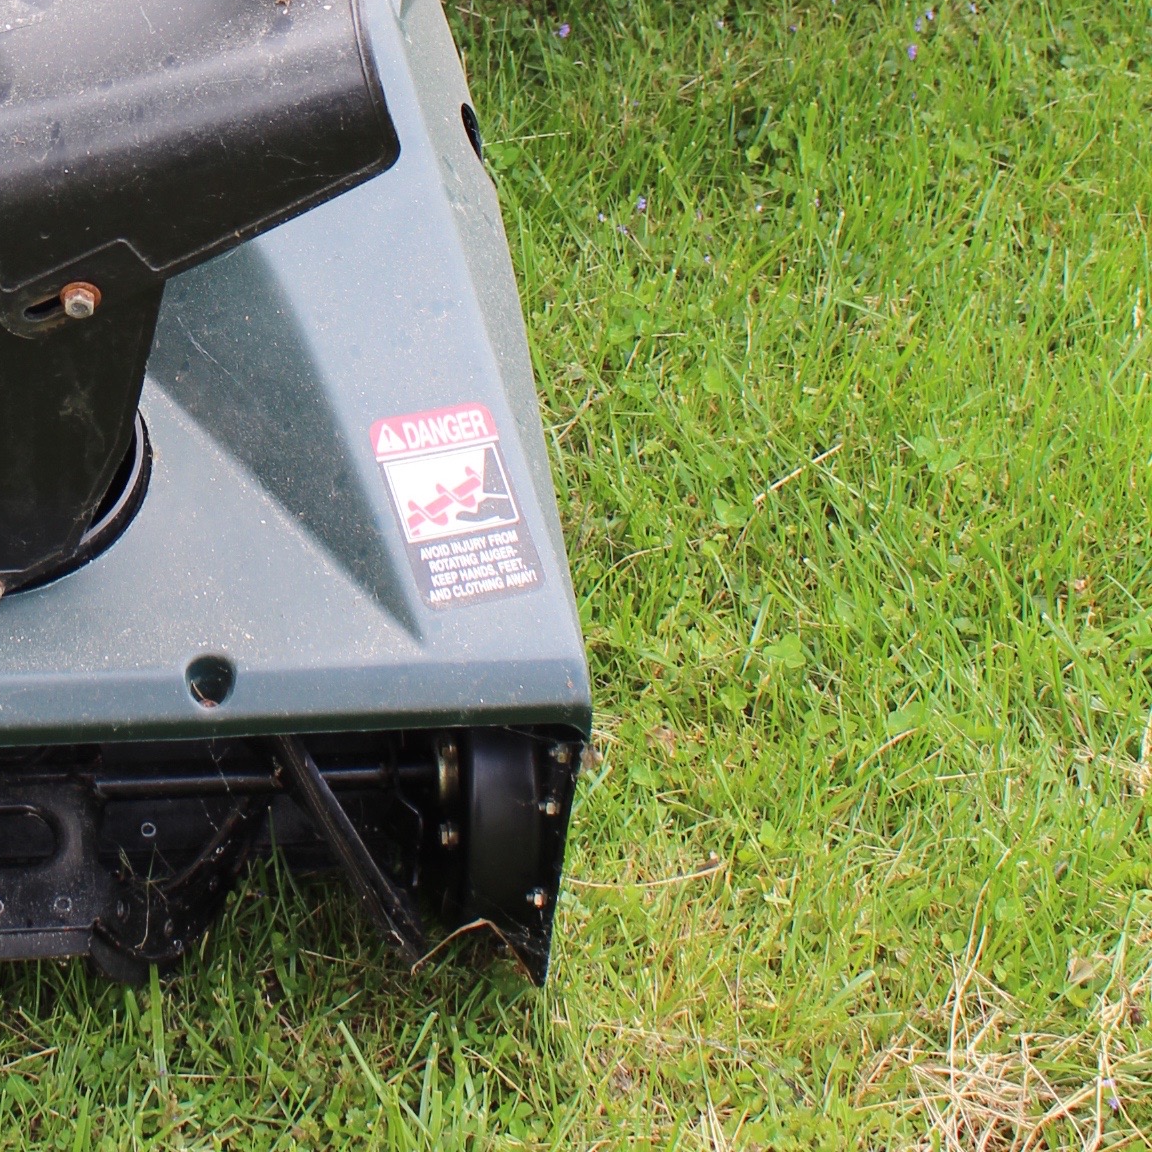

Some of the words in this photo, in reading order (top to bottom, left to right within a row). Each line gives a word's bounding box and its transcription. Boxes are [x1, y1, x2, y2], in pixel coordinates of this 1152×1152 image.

[402, 409, 489, 449] DANGER
[420, 545, 451, 561] AVOID
[451, 537, 487, 555] INJURY
[488, 530, 519, 547] FROM
[429, 553, 478, 573] ROTATING
[429, 586, 452, 603] AND
[452, 577, 505, 598] CLOTHING
[506, 570, 538, 588] AWAY!
[430, 572, 458, 587] KEEP
